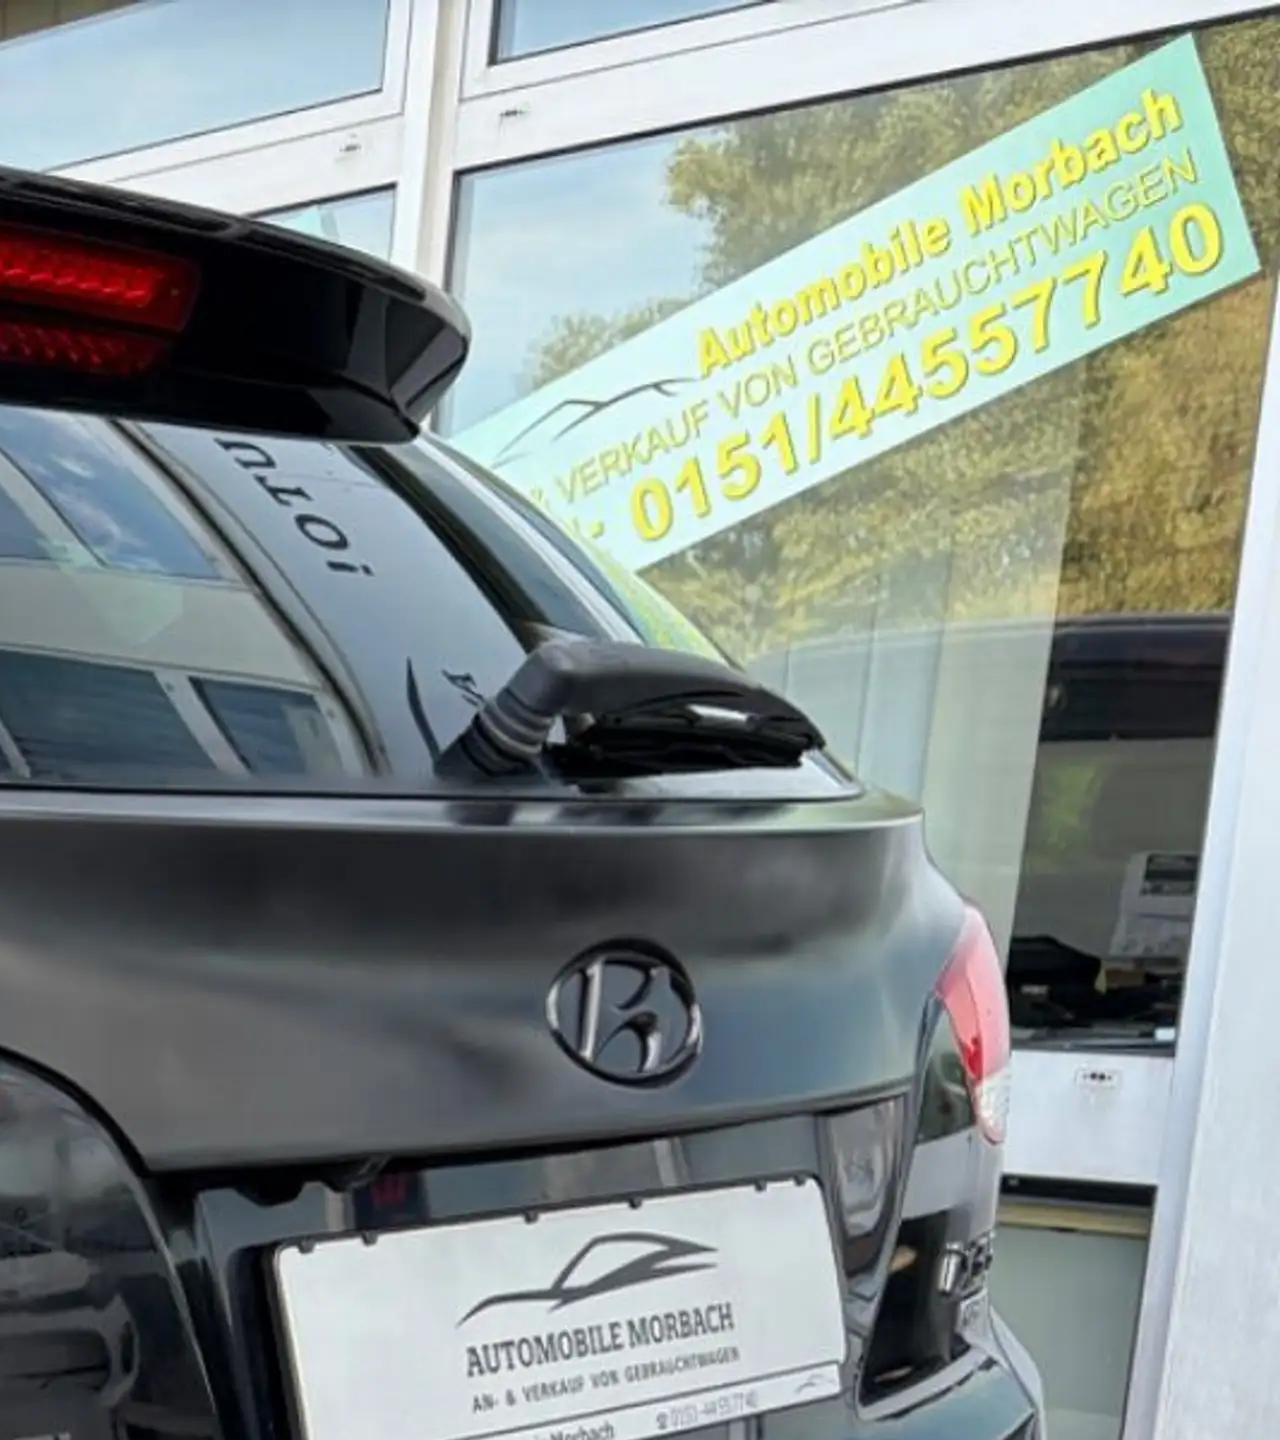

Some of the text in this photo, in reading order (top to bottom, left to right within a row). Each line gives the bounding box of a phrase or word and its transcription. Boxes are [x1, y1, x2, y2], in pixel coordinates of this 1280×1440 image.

[554, 408, 710, 505] VERKAUF
[717, 356, 797, 424] VON
[807, 146, 1200, 376] GEBRAUCHTWAGEN
[630, 203, 1225, 542] 0151/44557740
[697, 87, 1183, 379] Automobile Morbach
[466, 1303, 735, 1377] AUTOMOBILE MORBACH
[522, 1375, 585, 1402] VERKAUF
[591, 1368, 621, 1388] VON
